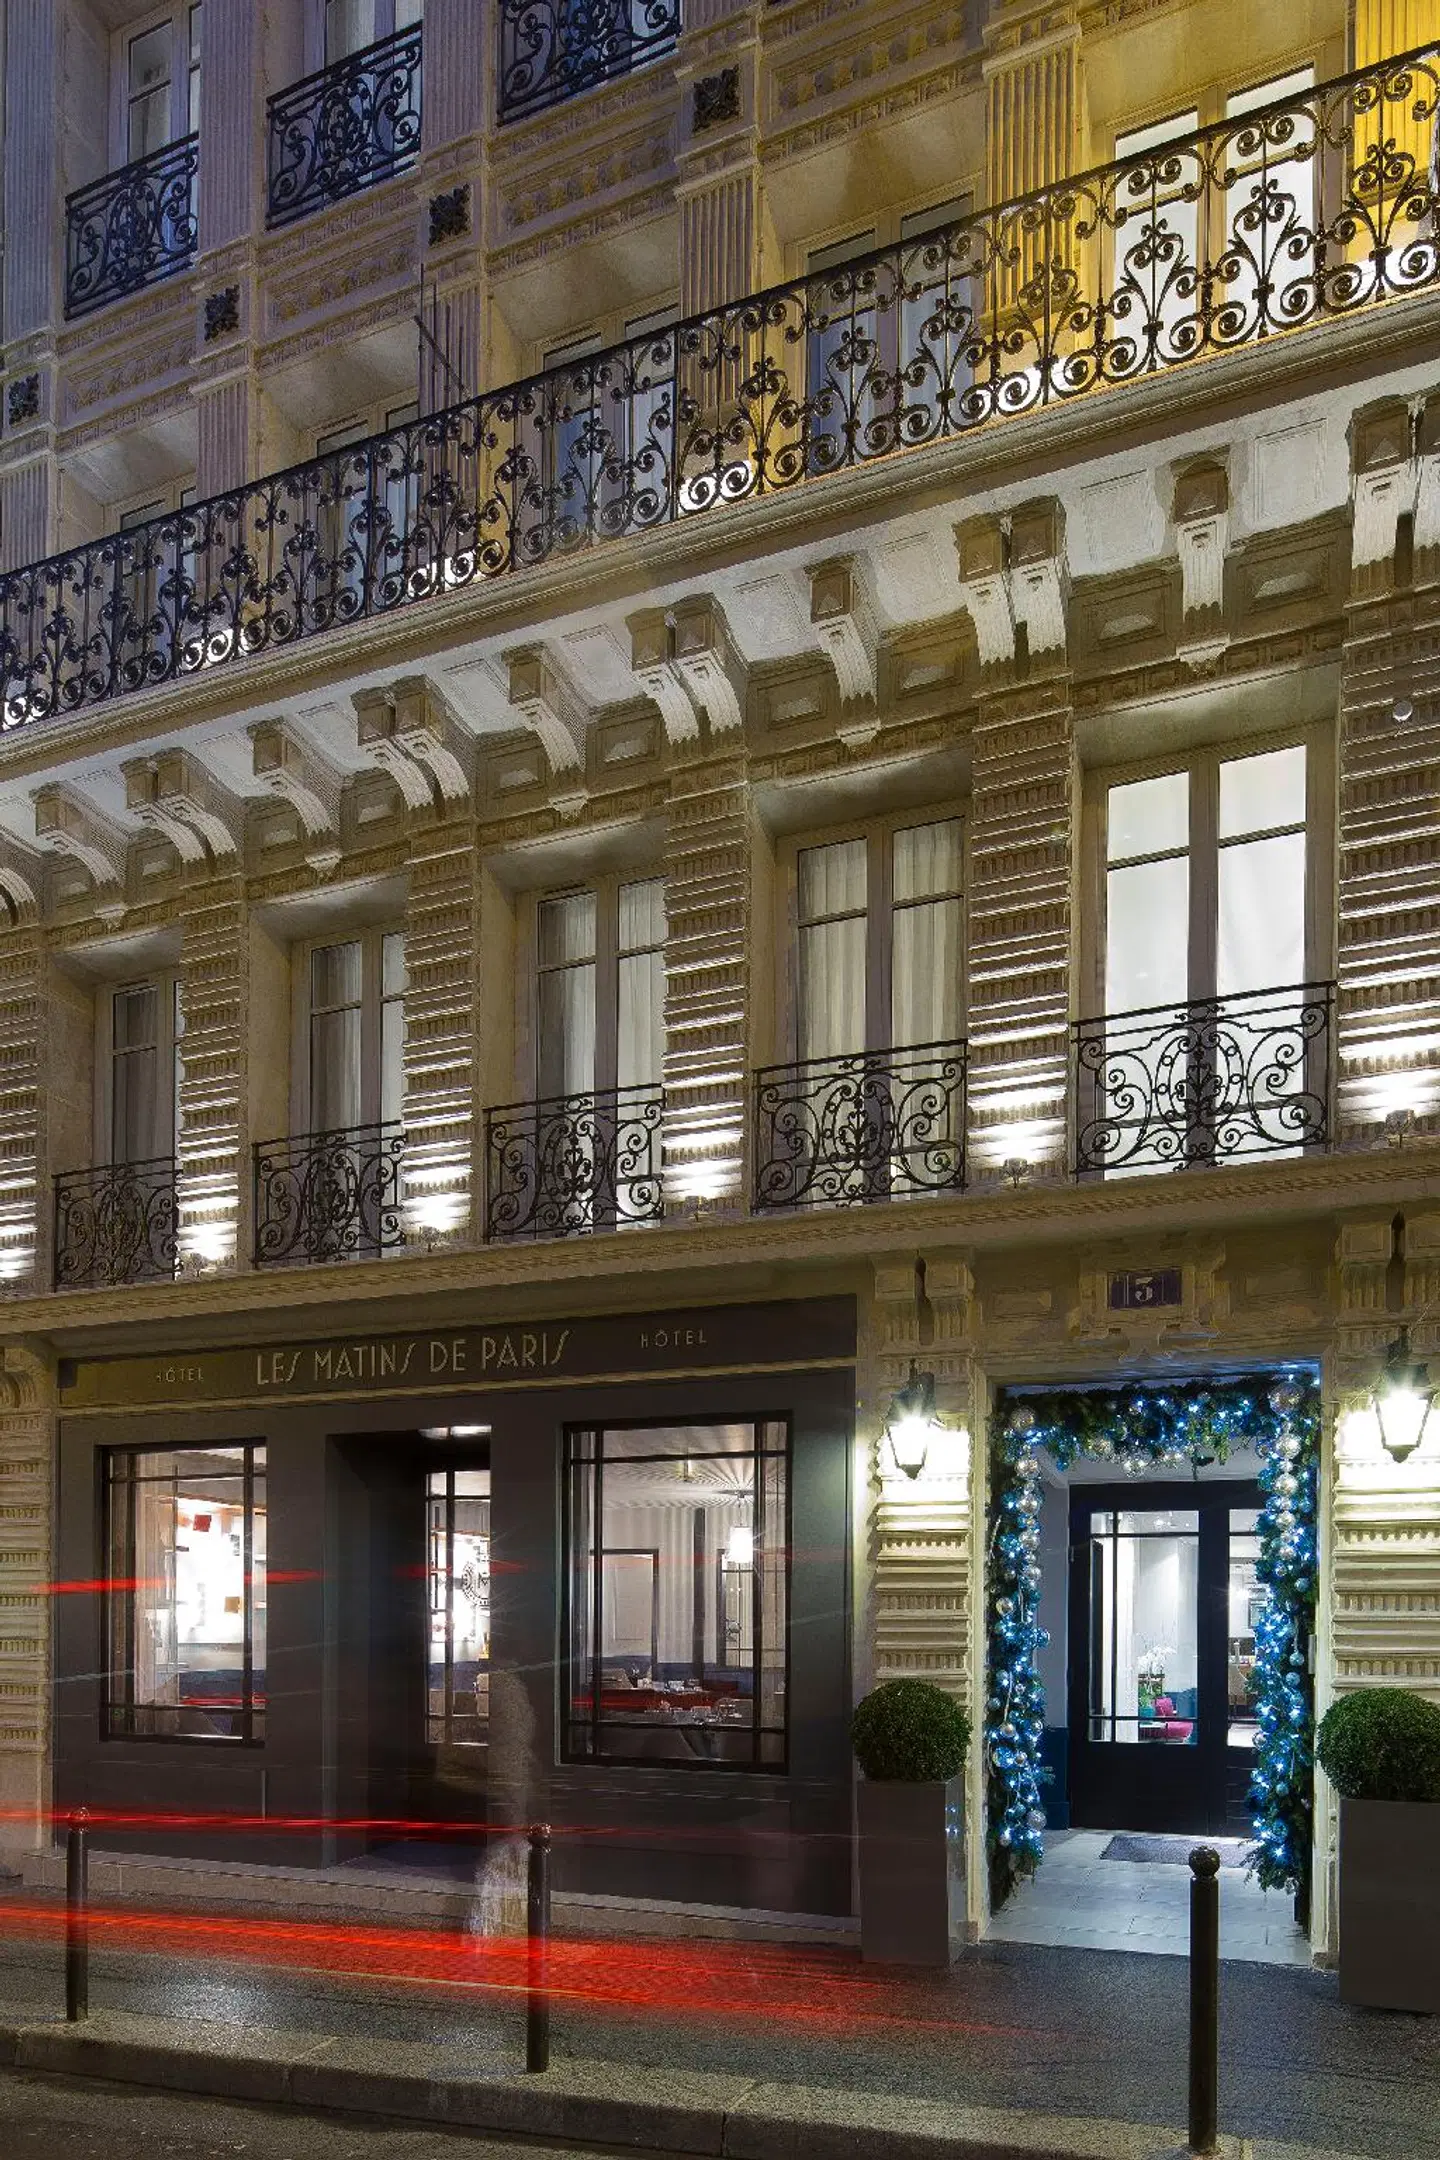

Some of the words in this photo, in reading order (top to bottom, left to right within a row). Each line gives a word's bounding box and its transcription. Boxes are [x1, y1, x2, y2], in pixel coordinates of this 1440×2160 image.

[256, 1350, 303, 1385] LES
[313, 1342, 418, 1382] MATINS
[429, 1338, 467, 1373] DE
[480, 1328, 574, 1371] PARIS
